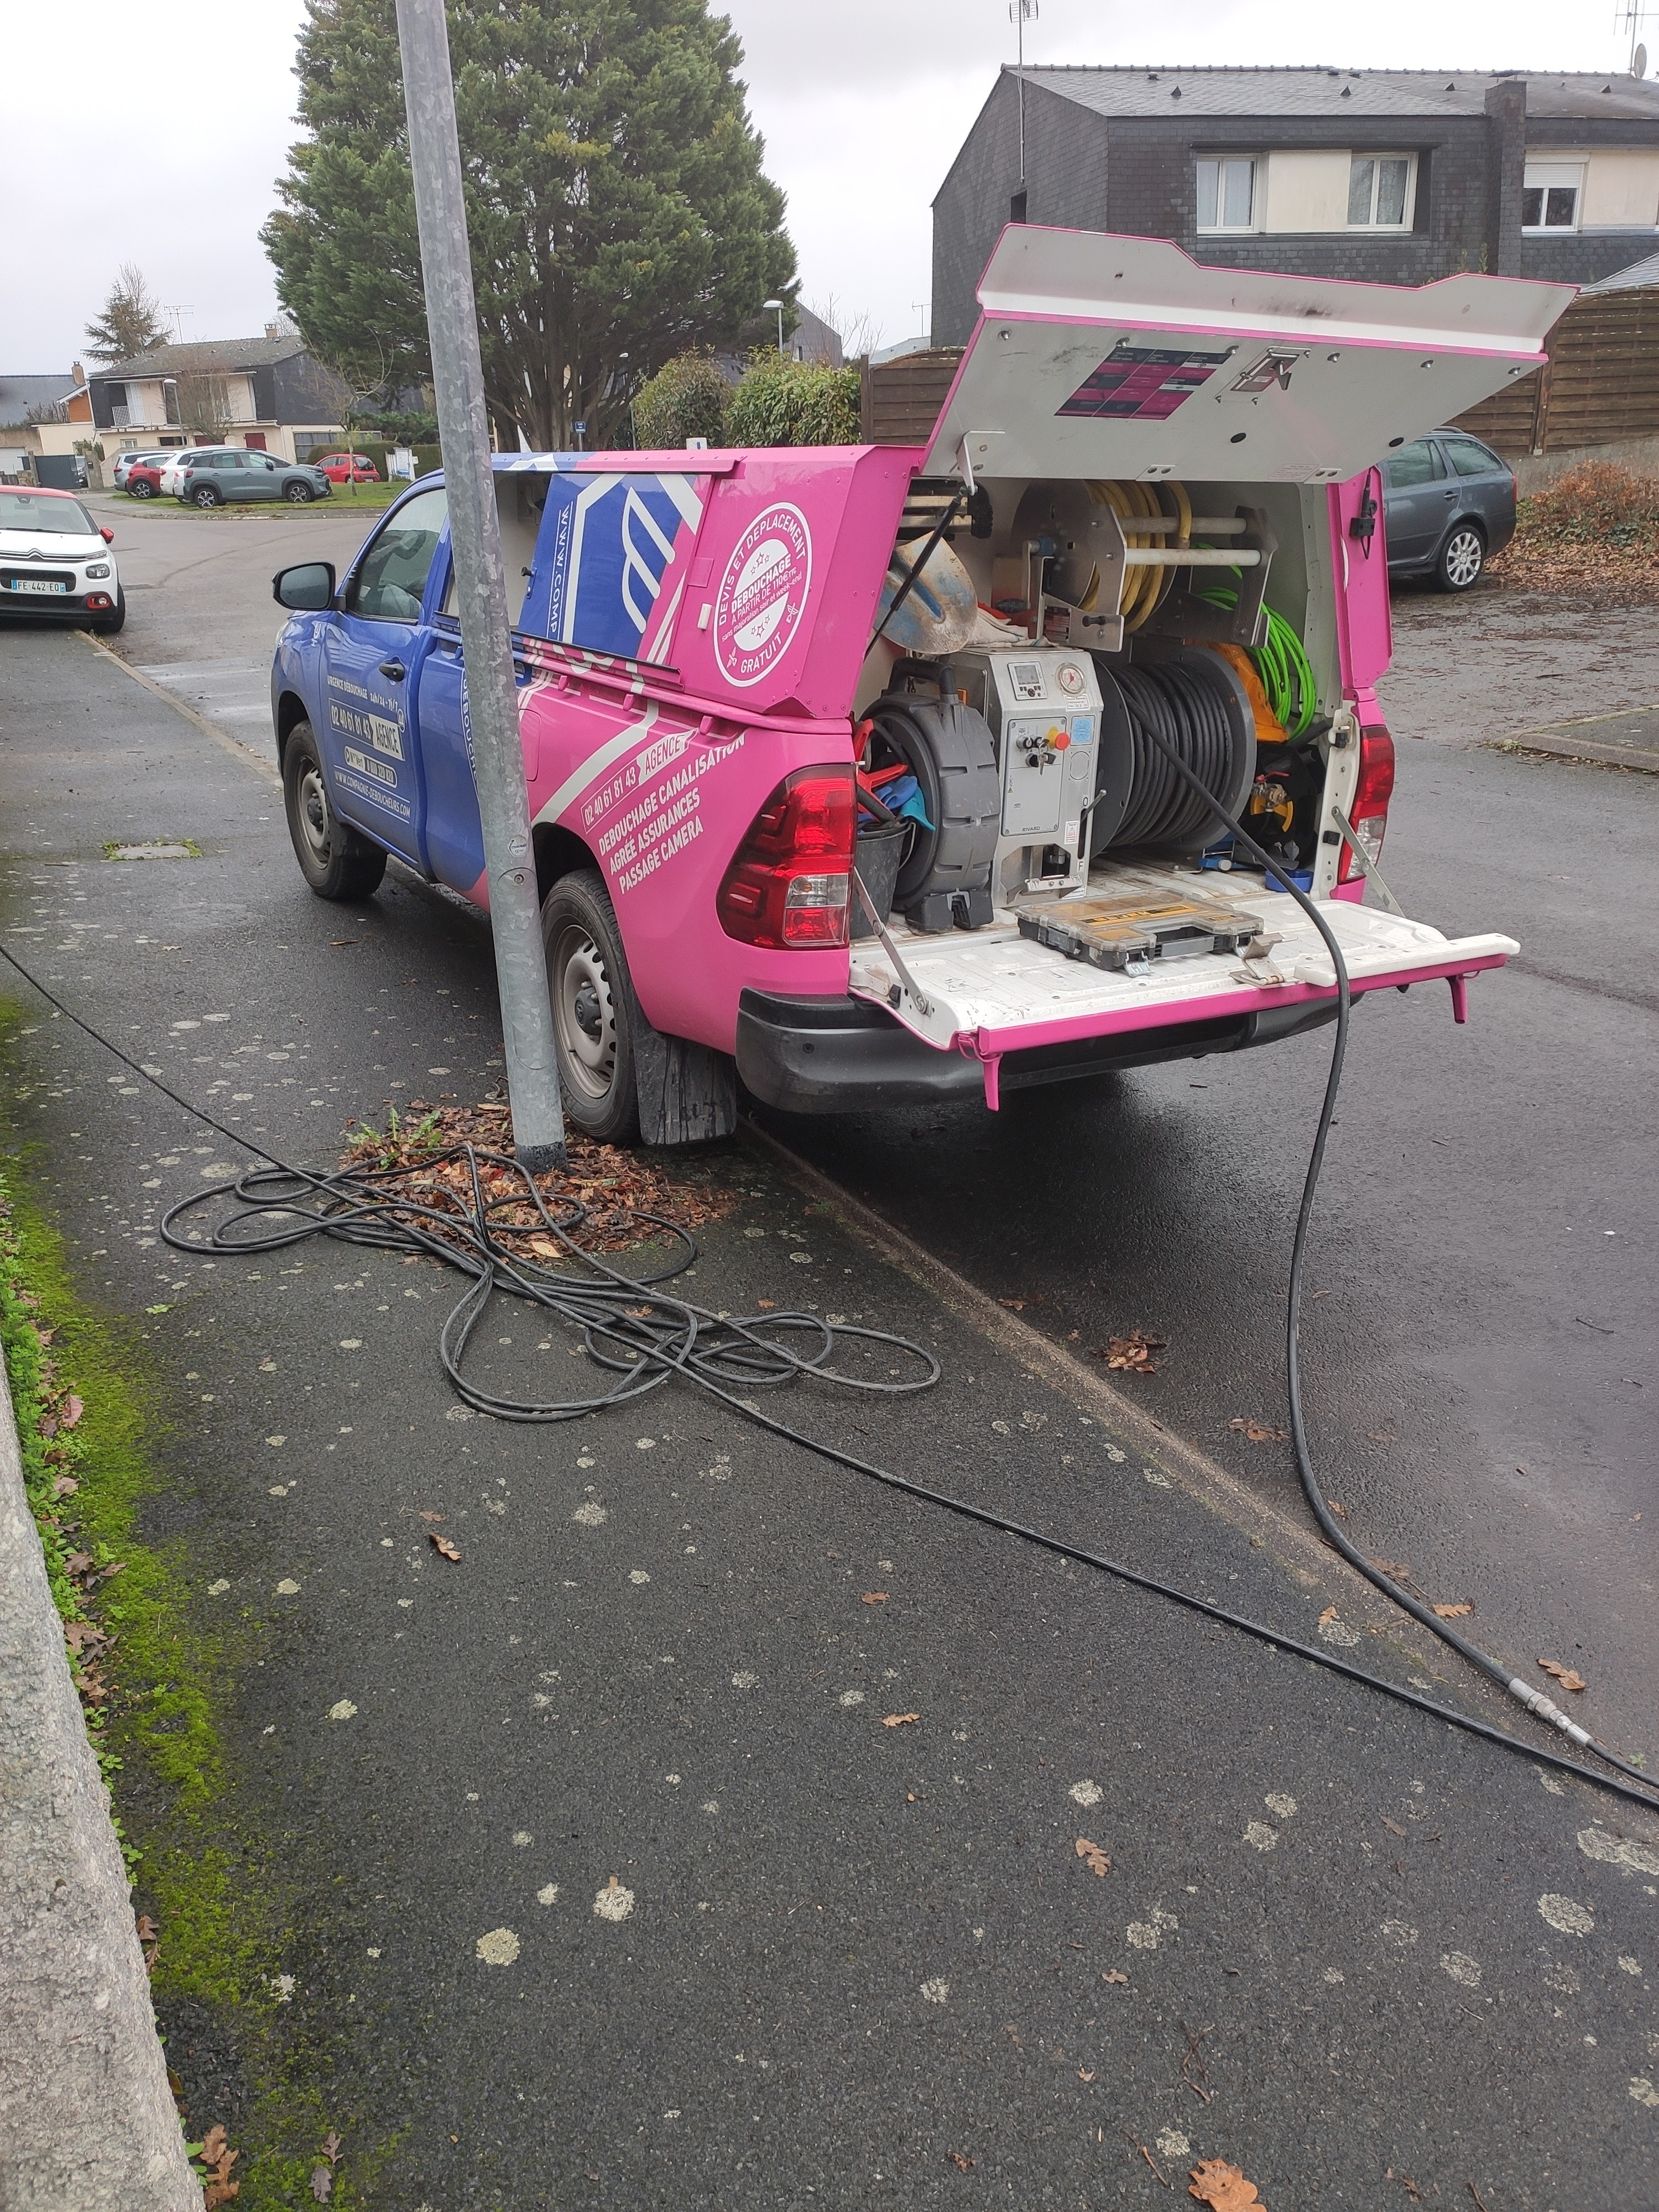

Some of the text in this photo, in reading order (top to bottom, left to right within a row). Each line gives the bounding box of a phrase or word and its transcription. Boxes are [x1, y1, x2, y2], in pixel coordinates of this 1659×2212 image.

[719, 514, 806, 626] DEVIS ET DEPLACEMENT
[732, 554, 791, 614] DEBOUCHAGE
[722, 629, 733, 643] sans
[733, 608, 759, 633] majoration
[759, 598, 769, 611] soir
[770, 593, 776, 602] et
[737, 593, 760, 620] PARTIR
[761, 584, 771, 600] DE
[740, 631, 782, 674] GRATUIT
[331, 705, 399, 754] 02 40 61 81 43 AGENCE
[585, 735, 685, 826] 02 40 61 81 43 AGENCE
[598, 791, 659, 857] DEBOUCHAGE
[610, 787, 700, 876] AGRÉÉ ASSURANCES
[619, 815, 704, 895] PASSAGE CAMERA
